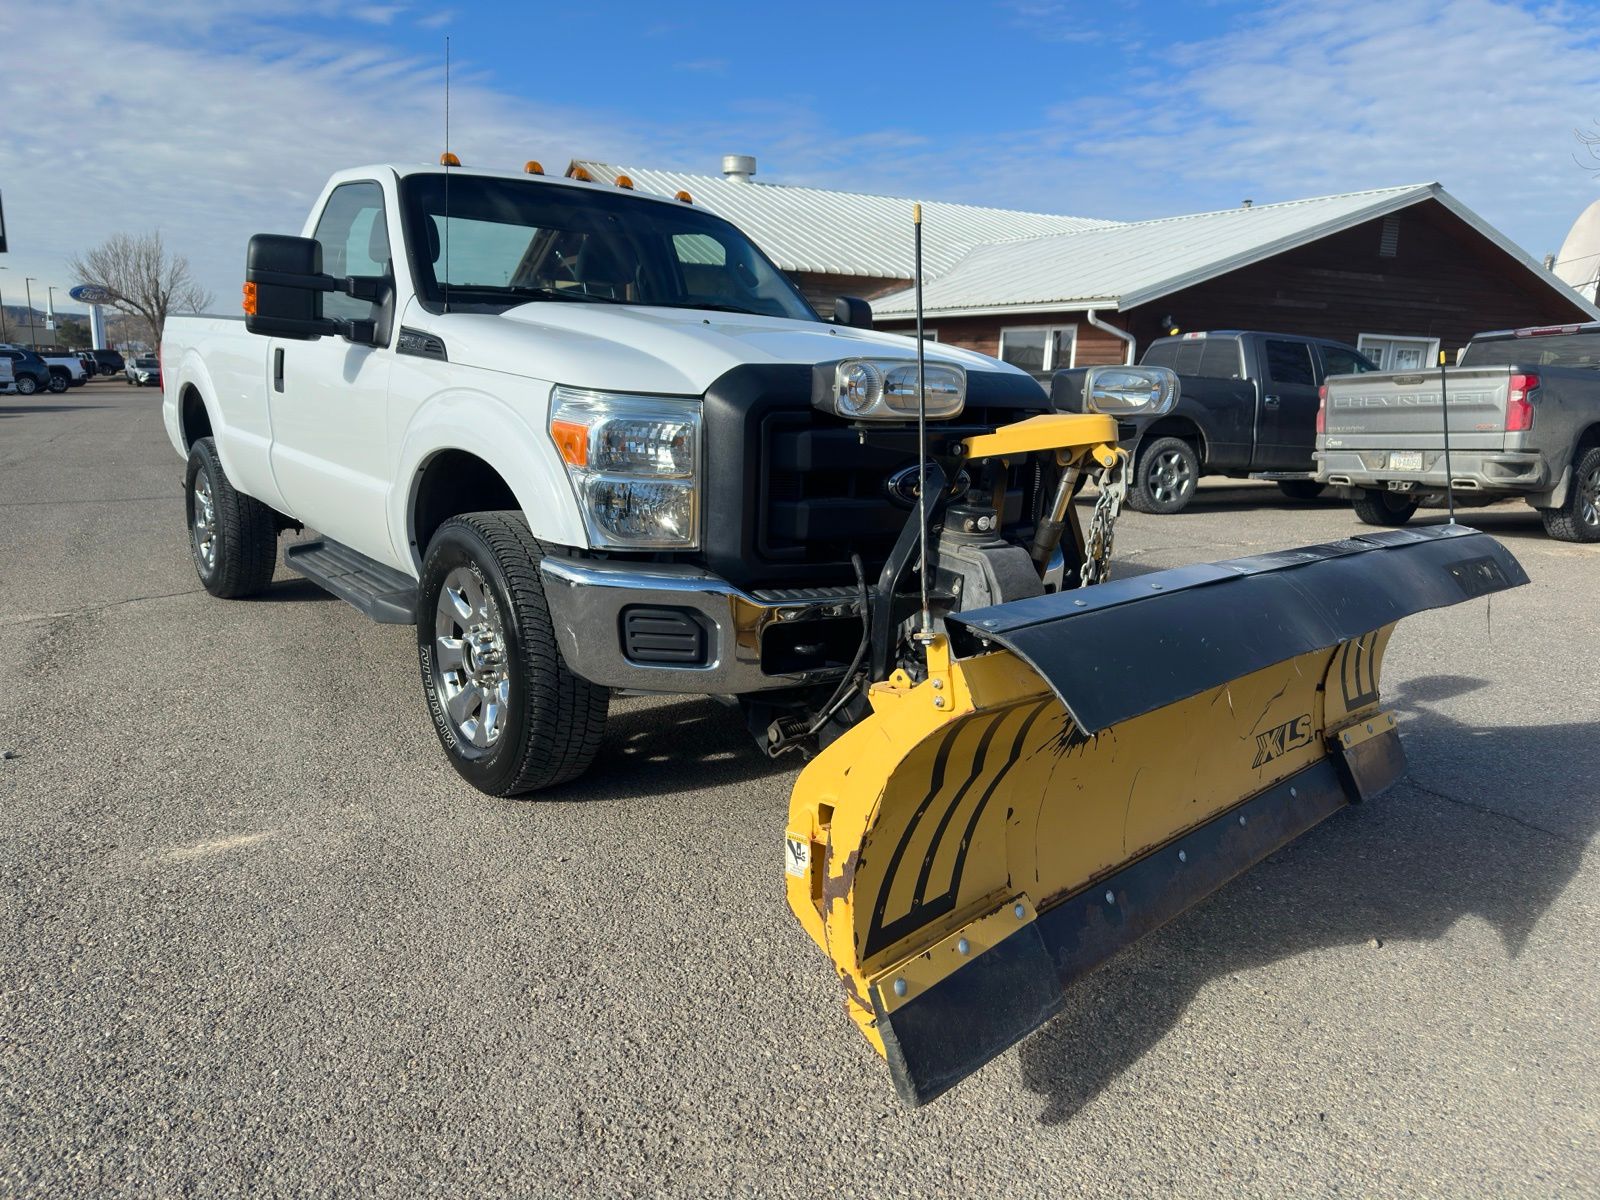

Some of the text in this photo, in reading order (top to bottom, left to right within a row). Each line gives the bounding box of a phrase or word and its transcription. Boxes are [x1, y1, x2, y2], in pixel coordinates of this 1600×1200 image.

[1334, 391, 1493, 408] CHEVROLET
[420, 645, 457, 750] MICHELIN
[1251, 713, 1313, 769] XLS
